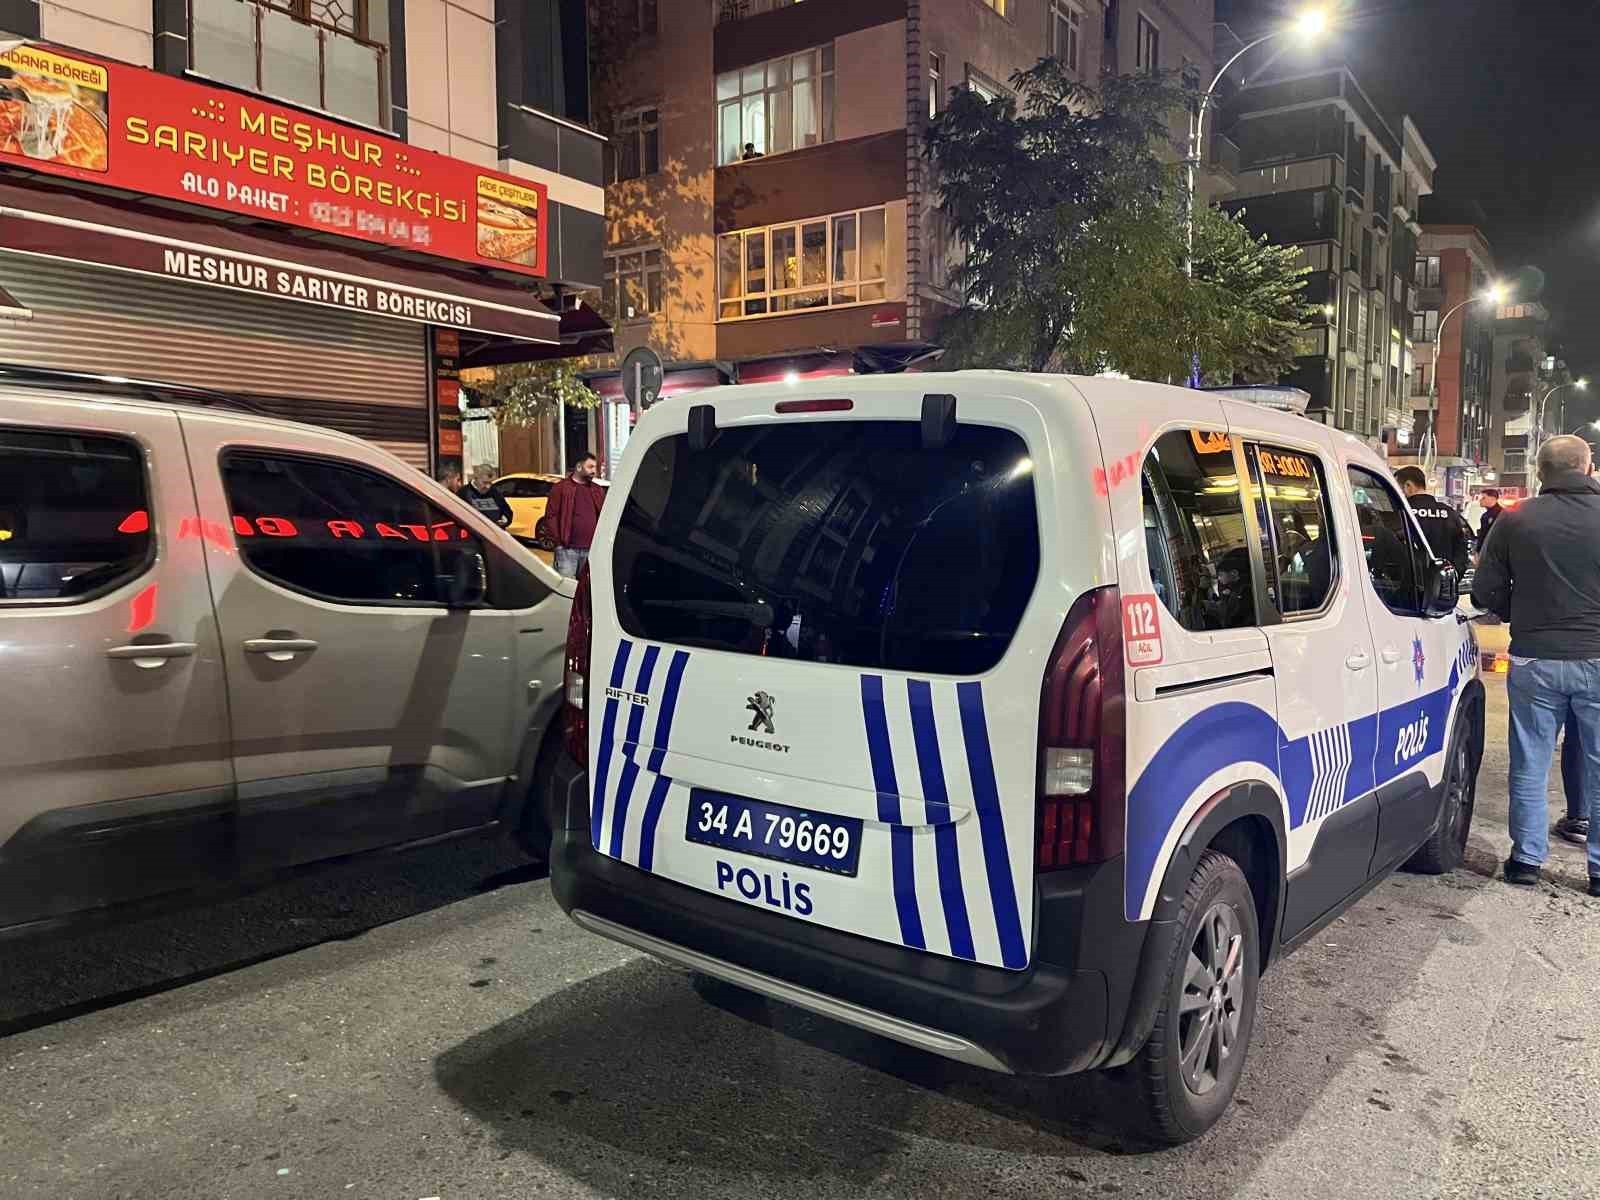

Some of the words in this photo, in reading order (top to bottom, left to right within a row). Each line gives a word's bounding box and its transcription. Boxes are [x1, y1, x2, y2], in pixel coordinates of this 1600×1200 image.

[239, 106, 383, 168] MEŞHUR
[126, 116, 294, 181] SARIYER
[307, 164, 467, 223] BÖREKÇİSİ
[180, 171, 219, 198] ALO
[276, 271, 369, 309] SARIYER
[1127, 601, 1156, 637] 112
[605, 687, 650, 706] RIFTER
[730, 735, 790, 753] PEUGEOT
[1394, 709, 1429, 766] POLİS
[698, 801, 728, 836] 34
[732, 809, 753, 841] A
[763, 812, 850, 860] 79669
[716, 860, 814, 916] POLİS
